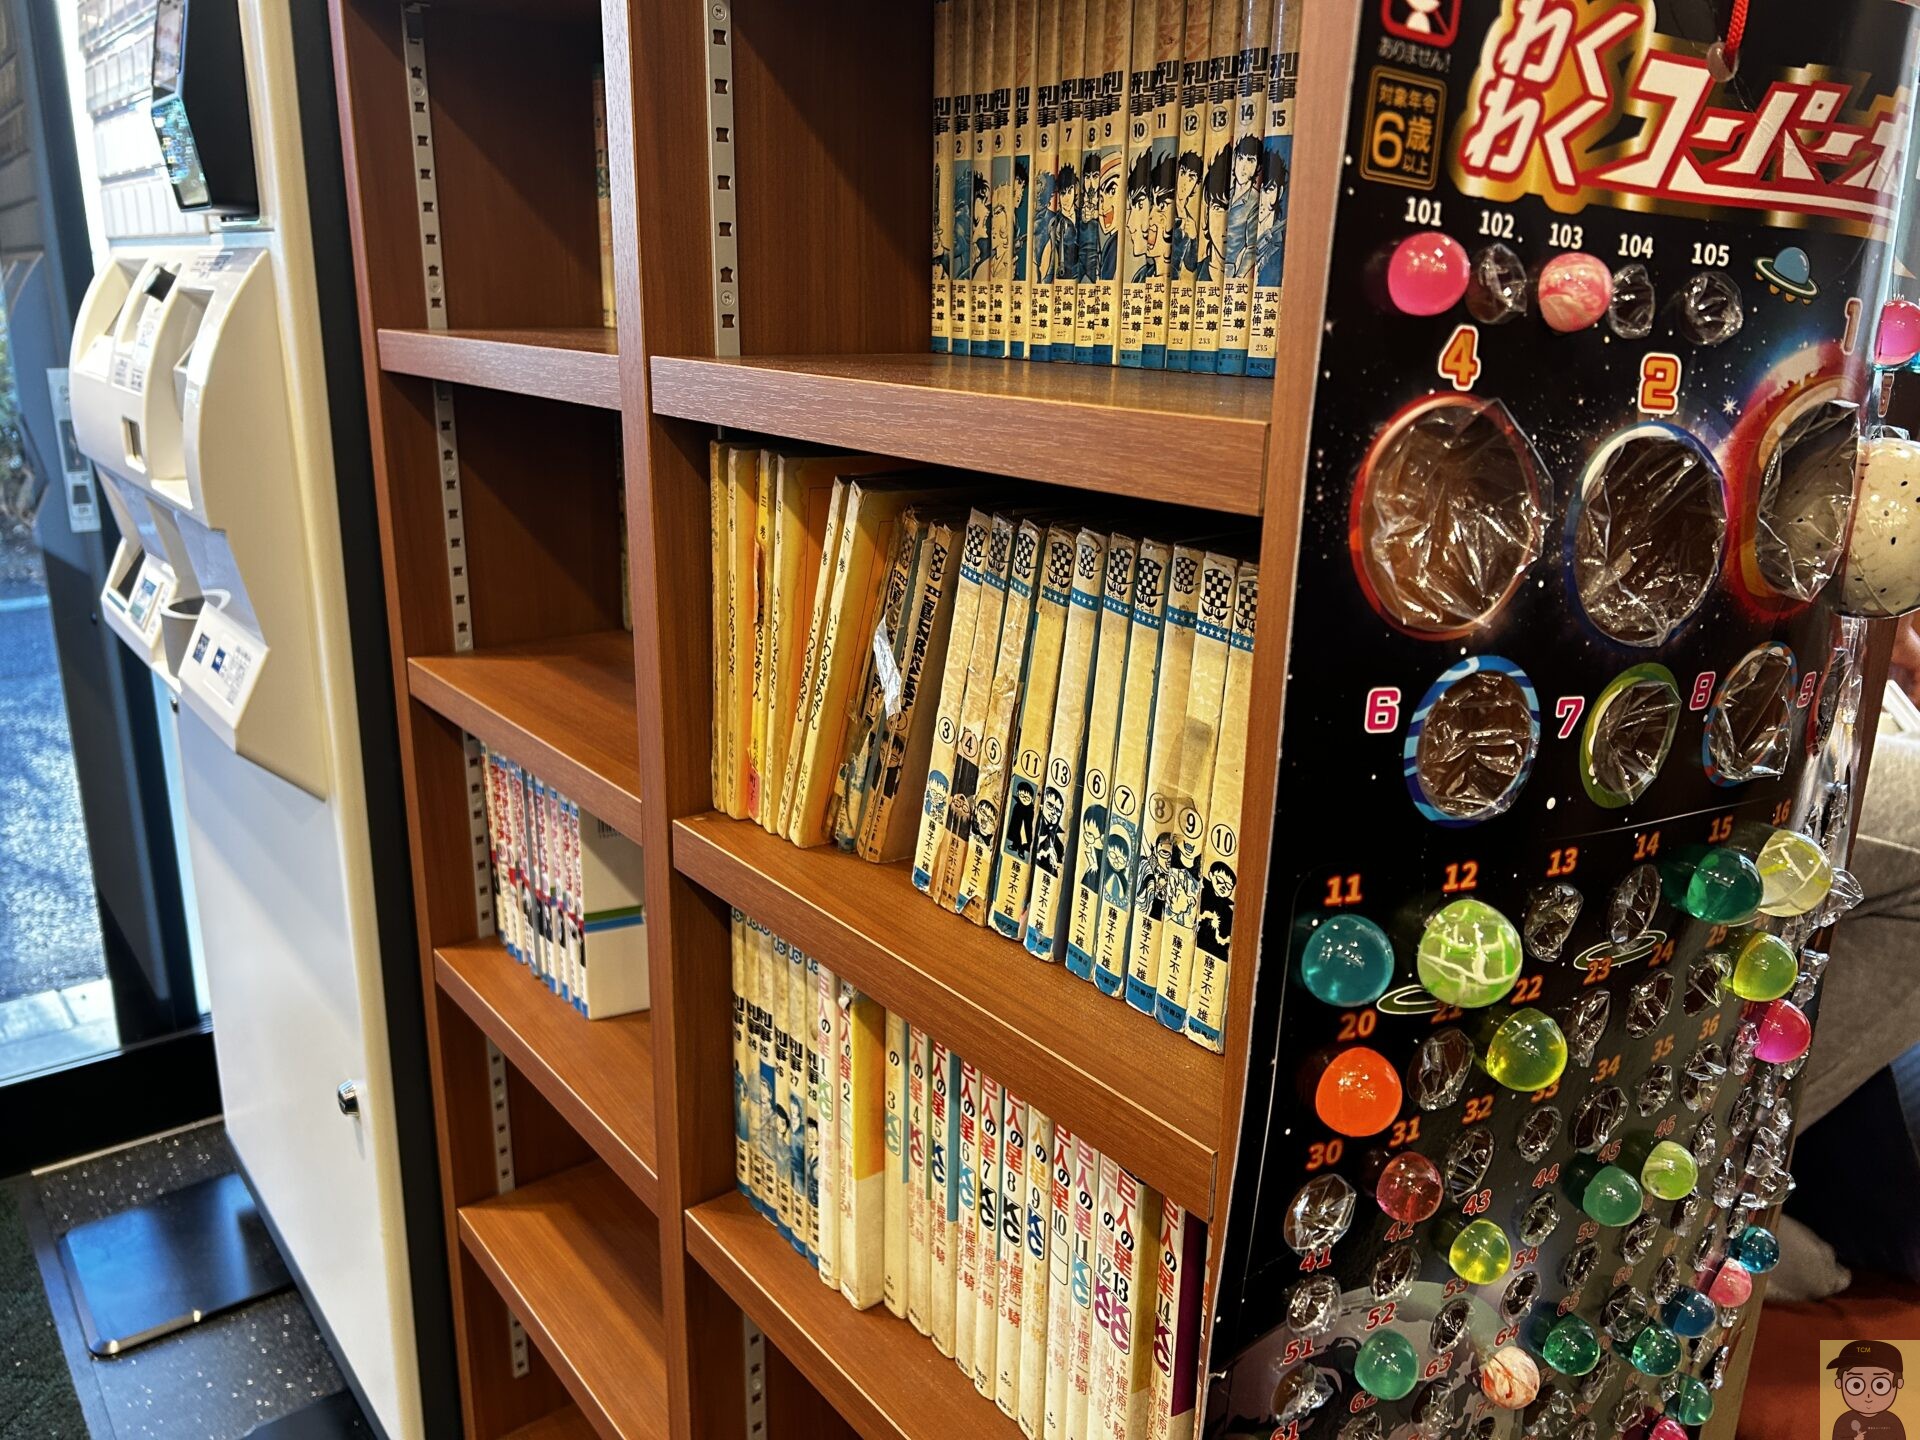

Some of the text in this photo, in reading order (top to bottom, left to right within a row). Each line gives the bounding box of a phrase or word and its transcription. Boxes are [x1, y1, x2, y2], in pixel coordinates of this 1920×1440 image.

[1104, 124, 1112, 138] 9
[1157, 113, 1166, 129] 11
[1272, 109, 1286, 127] 15
[976, 140, 983, 153] 3
[1015, 134, 1022, 147] 5
[1065, 128, 1072, 142] 7
[1404, 197, 1442, 228] 101
[1479, 211, 1515, 240] 102
[1548, 222, 1584, 250] 103
[1617, 233, 1654, 260] 104
[1691, 242, 1730, 268] 105
[1178, 287, 1192, 331] 武論尊
[1205, 287, 1220, 331] 武論尊
[1222, 283, 1234, 328] 平松伸二
[1233, 283, 1248, 329] 武論尊
[1251, 292, 1264, 337] 平松伸二
[1263, 292, 1278, 338] 武論尊
[1843, 297, 1863, 355] 1
[1255, 344, 1268, 352] 235
[1439, 325, 1480, 391] 4
[1638, 352, 1681, 415] 2
[1689, 671, 1716, 711] 8
[1797, 671, 1817, 708] 9
[1364, 686, 1401, 733] 6
[1556, 696, 1585, 739] 7
[1772, 800, 1791, 825] 16
[1708, 815, 1734, 843] 15
[922, 820, 937, 873] 藤子不二雄
[1633, 831, 1661, 860] 14
[1442, 861, 1479, 892] 12
[1546, 847, 1579, 877] 13
[1004, 861, 1021, 918] 藤子不二雄
[1034, 873, 1051, 936] 藤子不二雄
[1323, 874, 1363, 906] 11
[1075, 887, 1090, 949] 藤子不二雄
[1101, 907, 1117, 970] 藤子不二雄
[1136, 917, 1153, 982] 藤子不二雄
[1705, 926, 1728, 948] 25
[1165, 935, 1183, 1001] 藤子不二雄
[1649, 939, 1675, 967] 24
[1583, 957, 1613, 986] 23
[1196, 955, 1215, 1024] 藤子不二雄
[1511, 975, 1545, 1005] 22
[1337, 1010, 1376, 1041] 20
[1697, 1013, 1721, 1041] 36
[1650, 1034, 1675, 1061] 35
[789, 1072, 799, 1087] 27
[820, 1058, 827, 1078] 1
[1594, 1055, 1622, 1083] 34
[808, 1086, 818, 1101] 28
[843, 1082, 851, 1102] 2
[887, 1090, 896, 1110] 3
[913, 1106, 921, 1124] 4
[960, 1061, 976, 1162] 巨人の星 6
[1461, 1094, 1495, 1125] 32
[934, 1122, 942, 1138] 5
[981, 1074, 999, 1179] 巨人の星 7
[1388, 1117, 1421, 1149] 31
[1654, 1114, 1677, 1139] 46
[932, 1137, 945, 1183] KC
[1305, 1139, 1344, 1172] 30
[1598, 1139, 1622, 1164] 45
[1007, 1171, 1016, 1192] 8
[1053, 1124, 1072, 1236] 巨人の星 10
[1531, 1162, 1560, 1190] 44
[980, 1180, 996, 1230] KC
[1032, 1187, 1041, 1209] 9
[1074, 1140, 1094, 1264] 巨人の星 11
[1462, 1189, 1492, 1217] 43
[1002, 1195, 1021, 1247] KC
[1027, 1204, 1045, 1258] KC
[1112, 1168, 1137, 1303] 巨人の星 13
[1383, 1221, 1414, 1243] 42
[1098, 1253, 1112, 1283] 12
[1158, 1197, 1178, 1326] 巨人の星 14
[1299, 1246, 1332, 1273] 41
[1512, 1246, 1539, 1272] 54
[1007, 1262, 1023, 1329] 梶原一騎
[1109, 1293, 1130, 1353] KC
[1364, 1301, 1397, 1331] 52
[1153, 1313, 1172, 1374] KC
[1494, 1324, 1520, 1347] 64
[1075, 1328, 1090, 1397] 梶原一騎
[1283, 1337, 1315, 1366] 51
[1425, 1352, 1454, 1378] 63
[1270, 1419, 1299, 1440] 61
